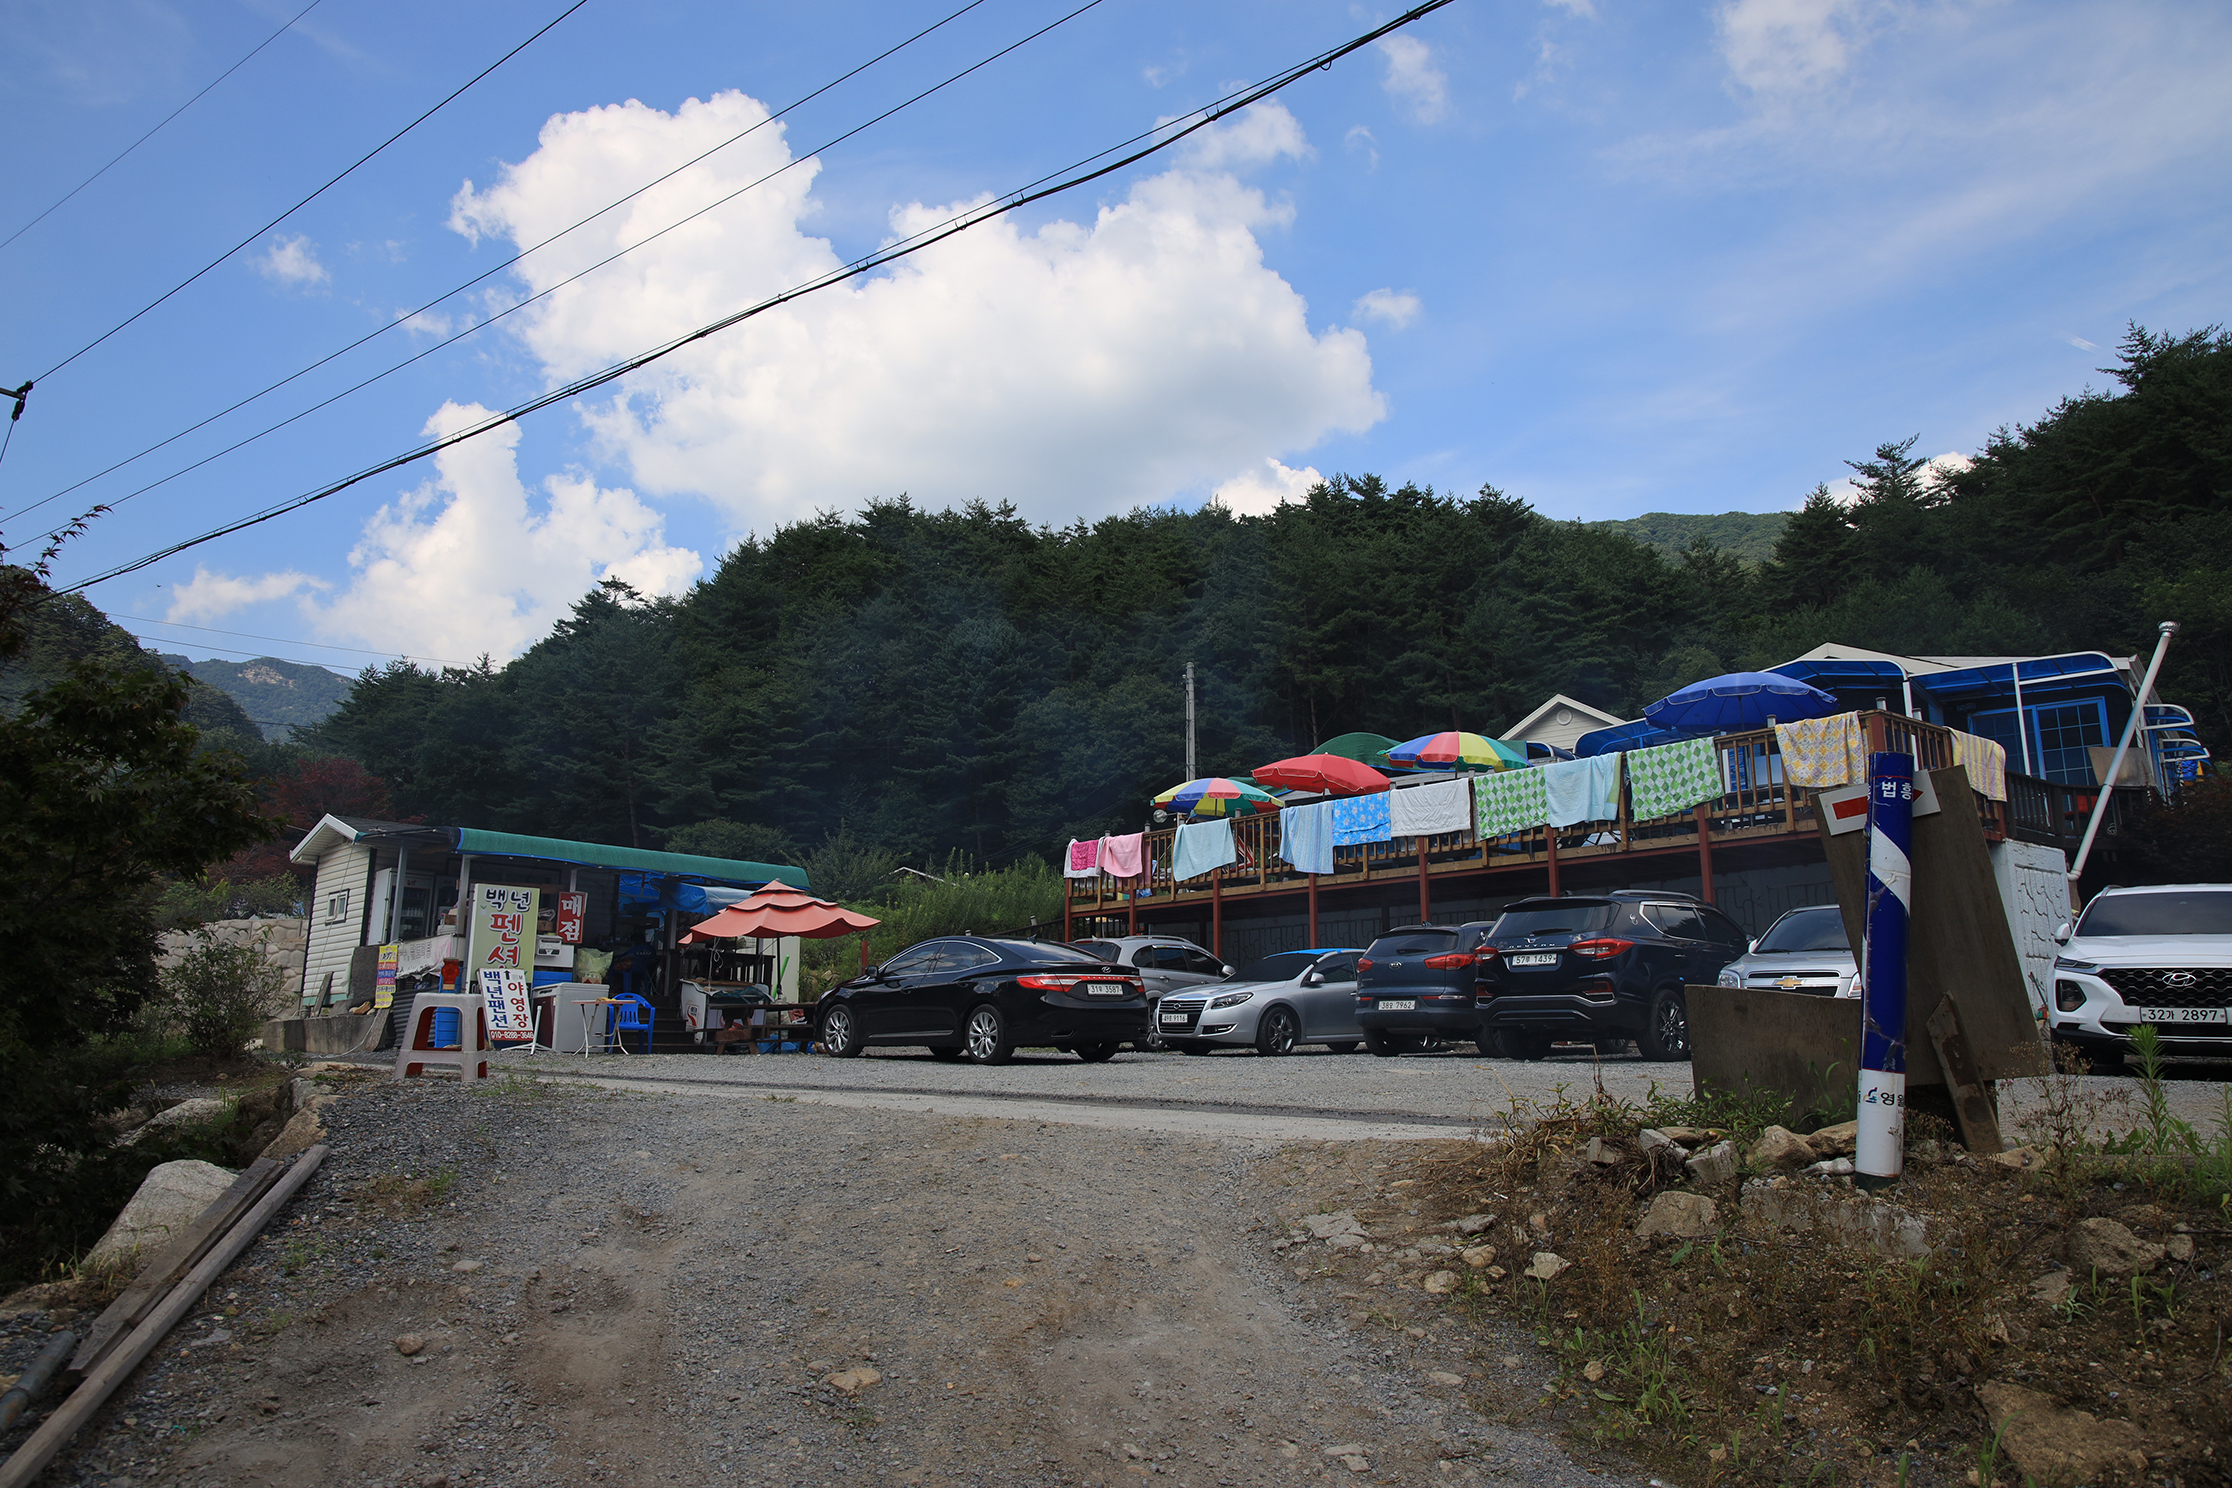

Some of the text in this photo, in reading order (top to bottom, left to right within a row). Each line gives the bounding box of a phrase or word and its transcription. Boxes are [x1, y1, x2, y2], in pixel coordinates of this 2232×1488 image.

[485, 888, 531, 912] 백년
[558, 894, 583, 942] 매점
[1534, 954, 1553, 963] 1439
[1105, 985, 1120, 993] 3587
[483, 971, 508, 1028] 백년팬션
[507, 981, 529, 1028] 야영장
[1396, 1001, 1412, 1009] 7962
[2147, 1009, 2218, 1021] 32가 2897
